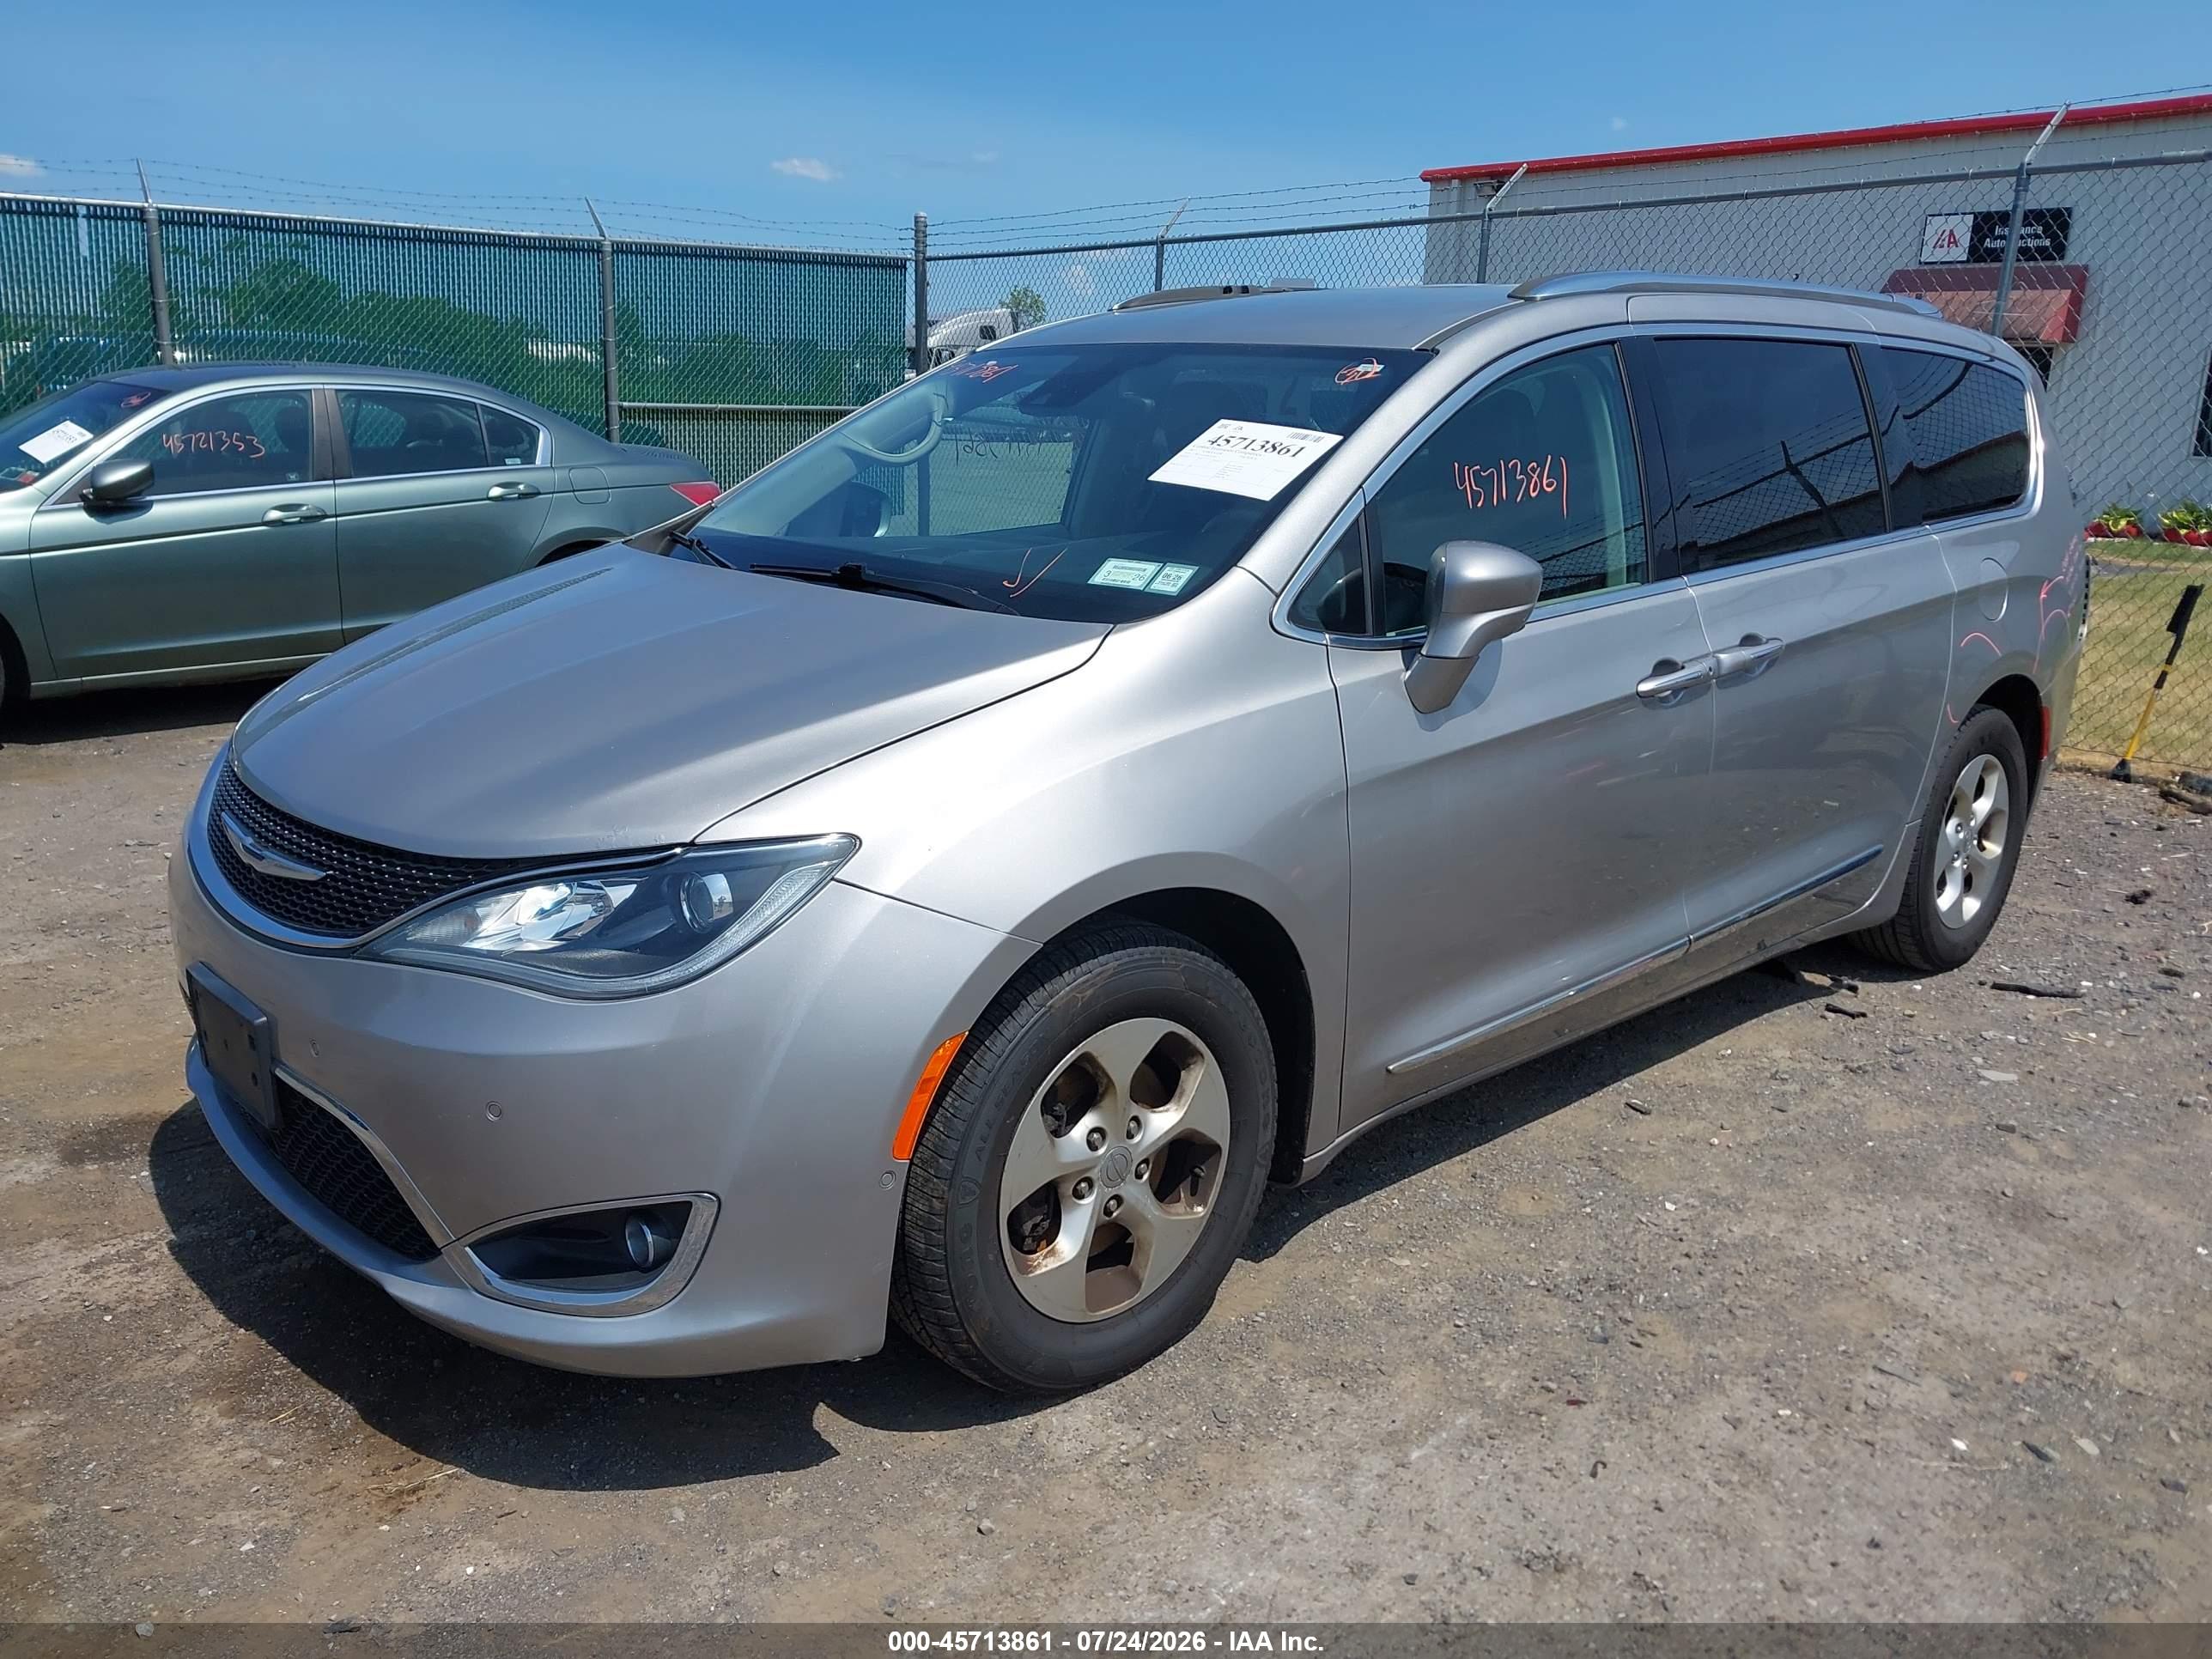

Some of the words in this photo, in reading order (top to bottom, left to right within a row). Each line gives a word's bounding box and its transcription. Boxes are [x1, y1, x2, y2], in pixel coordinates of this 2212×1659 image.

[1984, 237, 2006, 248] Auto
[2017, 236, 2051, 247] ctions
[1995, 225, 2043, 236] Insance
[162, 430, 265, 458] 45721353
[1207, 434, 1307, 458] 45713861
[1454, 454, 1567, 520] 45713861
